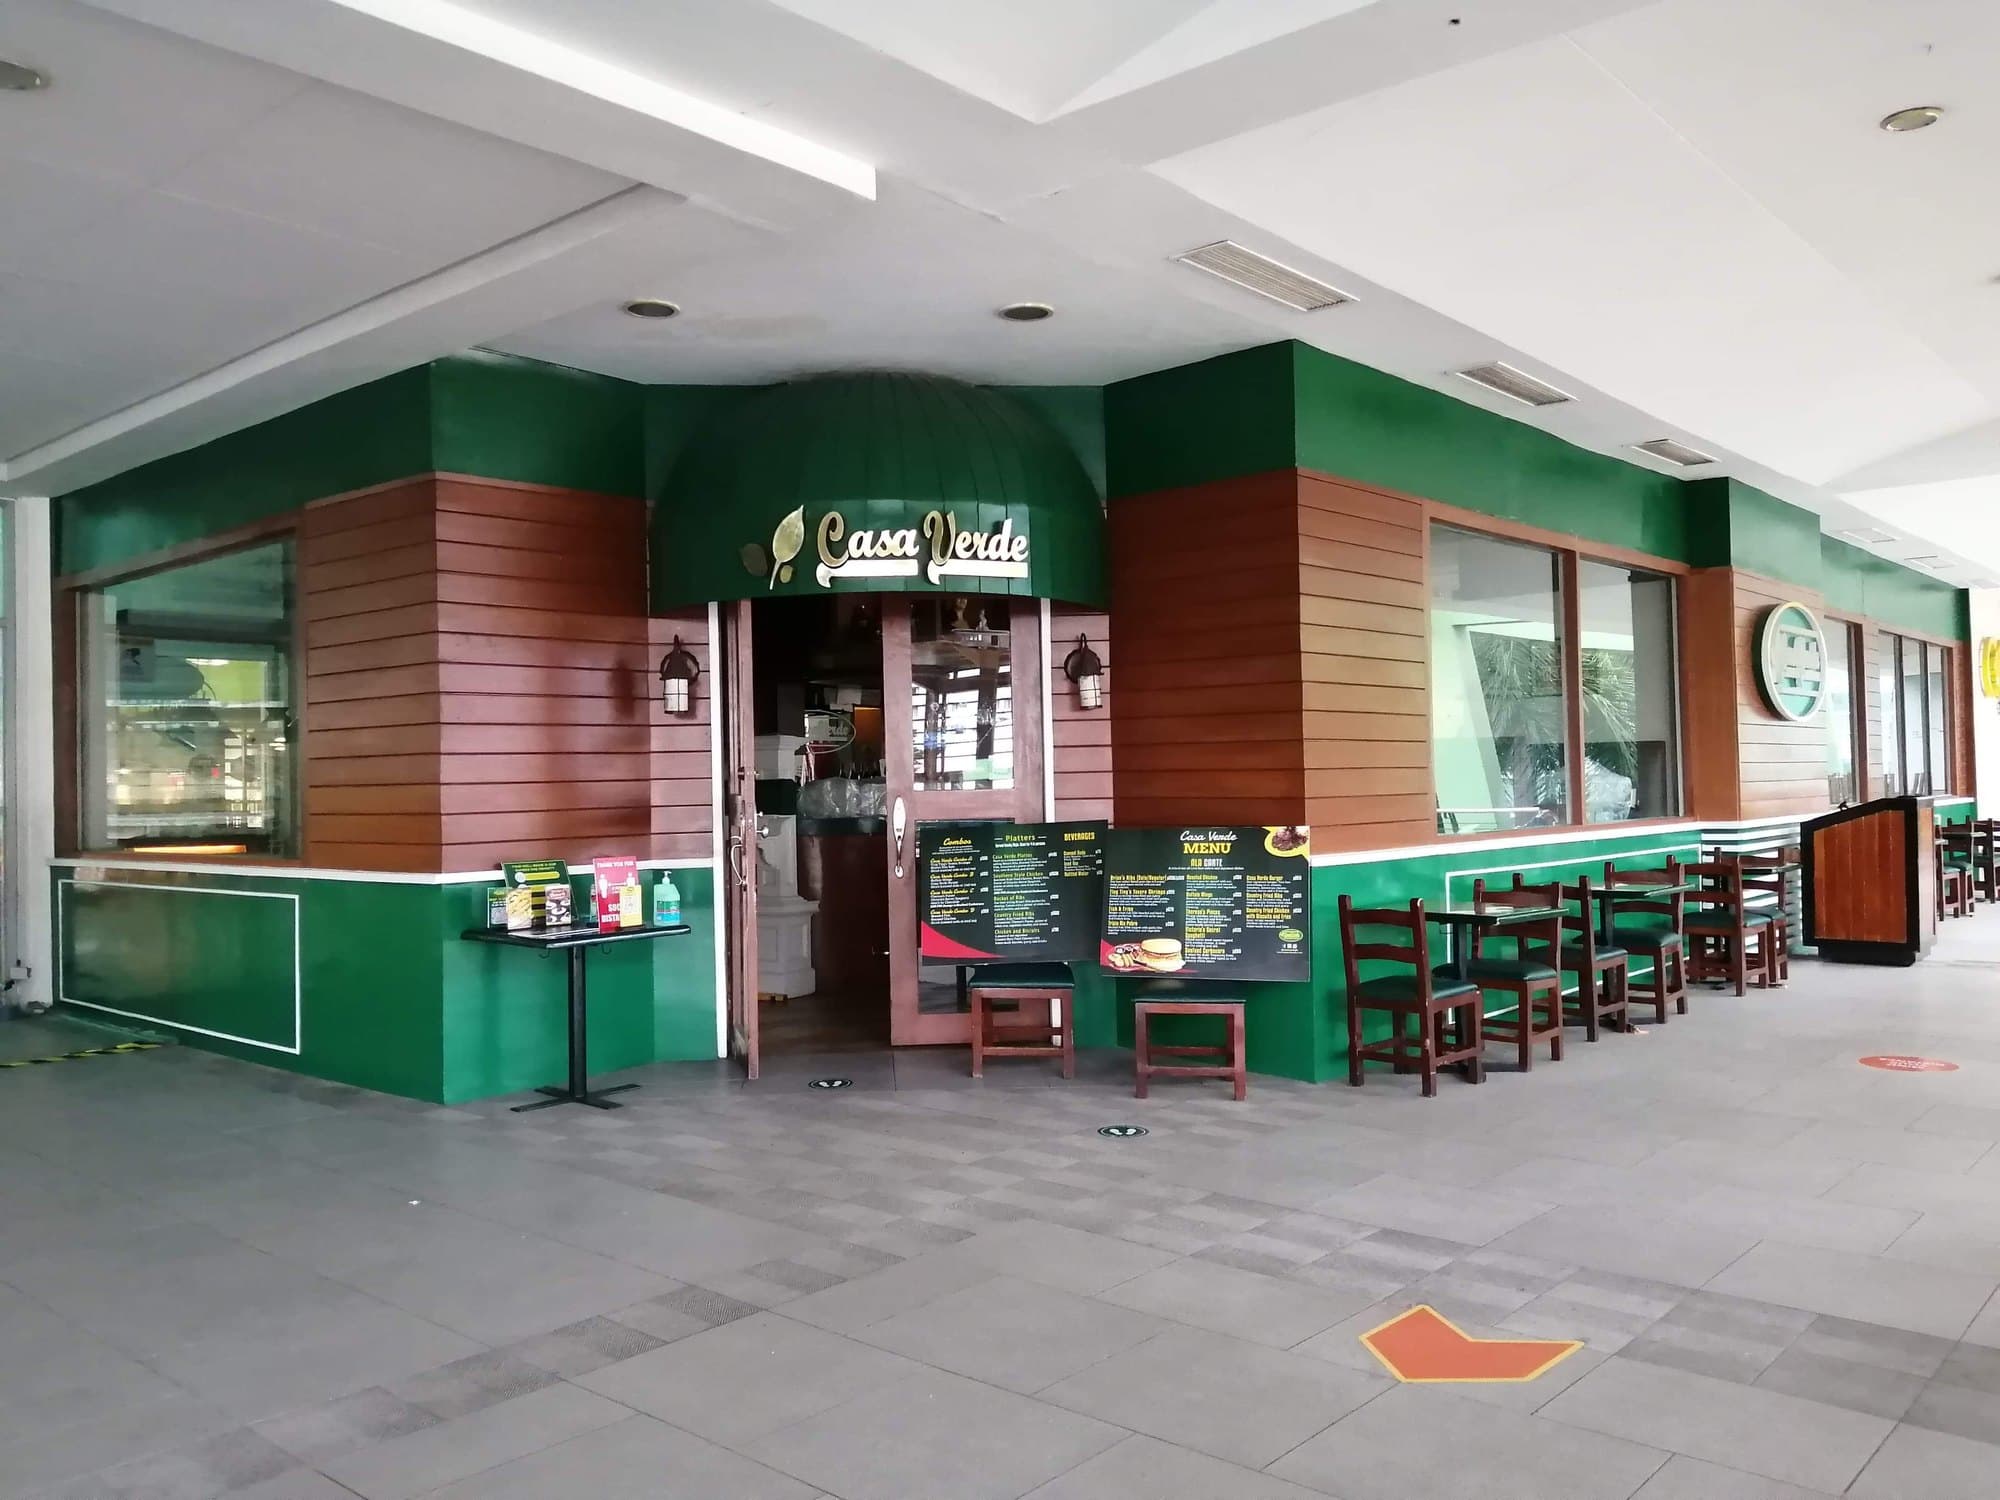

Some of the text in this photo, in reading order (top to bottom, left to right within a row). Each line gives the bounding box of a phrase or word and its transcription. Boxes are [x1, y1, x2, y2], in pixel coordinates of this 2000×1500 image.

[816, 510, 1029, 568] Casa Verde
[1064, 832, 1094, 841] BEVERAGES
[1180, 830, 1238, 841] Casa Verde
[944, 838, 972, 846] Combos
[1184, 842, 1232, 854] MENU
[1190, 858, 1202, 867] ALA
